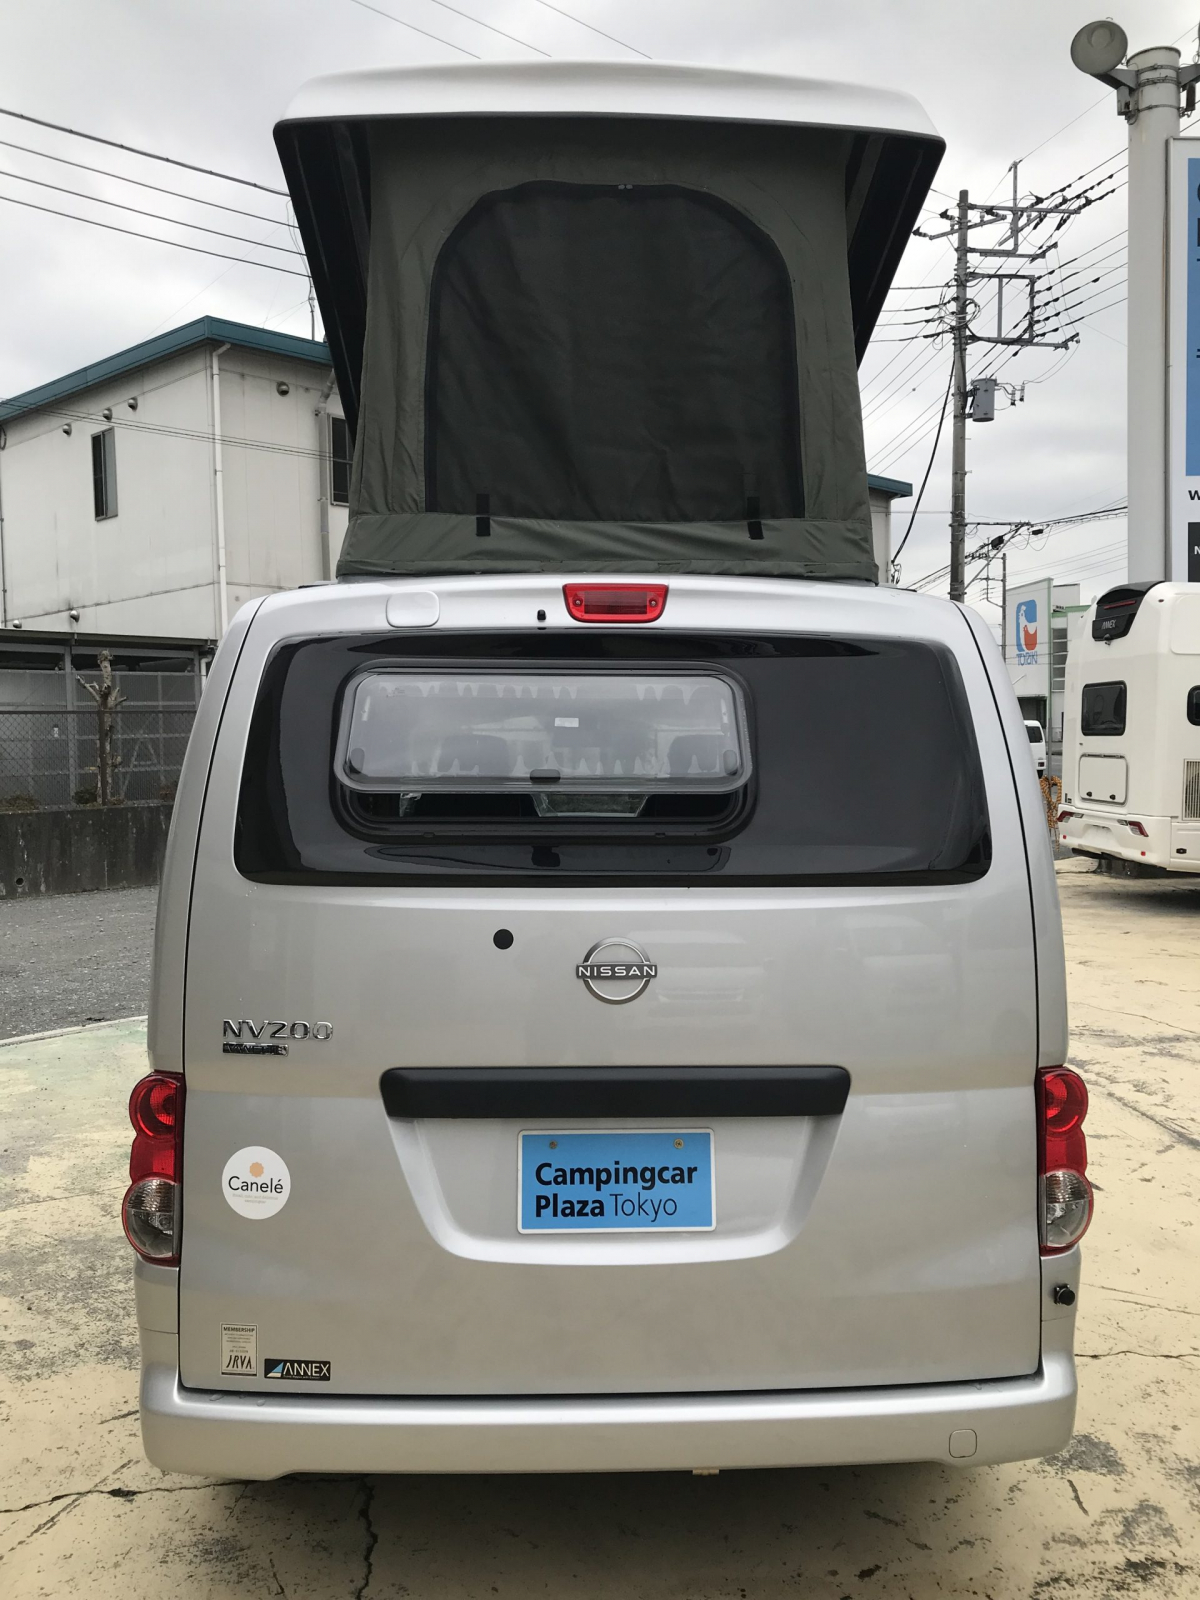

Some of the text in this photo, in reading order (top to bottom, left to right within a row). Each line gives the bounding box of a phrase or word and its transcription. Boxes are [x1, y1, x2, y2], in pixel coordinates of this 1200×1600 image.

[578, 966, 656, 977] NISSAN
[222, 1019, 333, 1041] NV200
[228, 1175, 284, 1194] Canelé
[535, 1160, 698, 1191] Campingcar
[535, 1192, 678, 1223] Plaza Tokyo
[225, 1354, 252, 1370] JRVA
[283, 1362, 330, 1377] ANNEX
